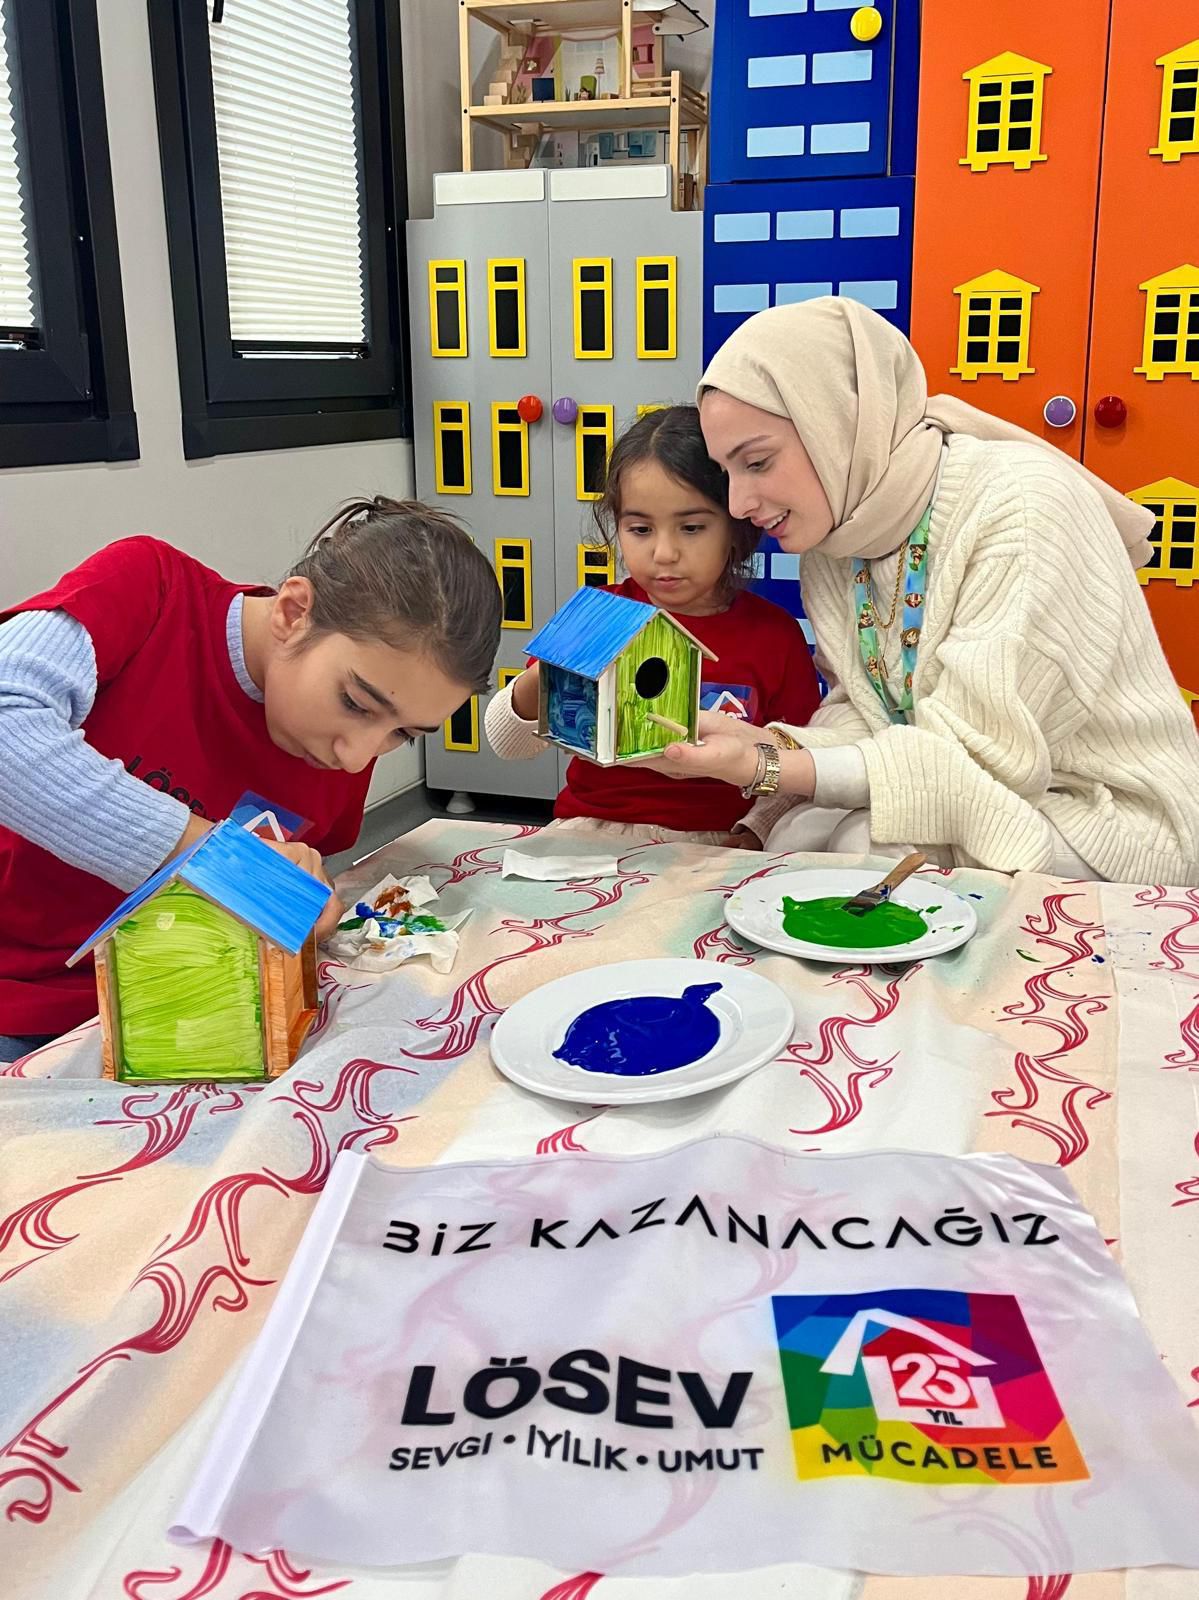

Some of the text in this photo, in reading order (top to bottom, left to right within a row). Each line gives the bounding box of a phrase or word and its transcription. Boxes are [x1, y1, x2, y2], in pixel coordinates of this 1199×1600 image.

[400, 1349, 754, 1429] LÖSEV
[892, 1352, 972, 1407] 25
[926, 1408, 964, 1426] YIL
[658, 1447, 764, 1473] UMUT
[820, 1434, 1058, 1470] MÜCADELE
